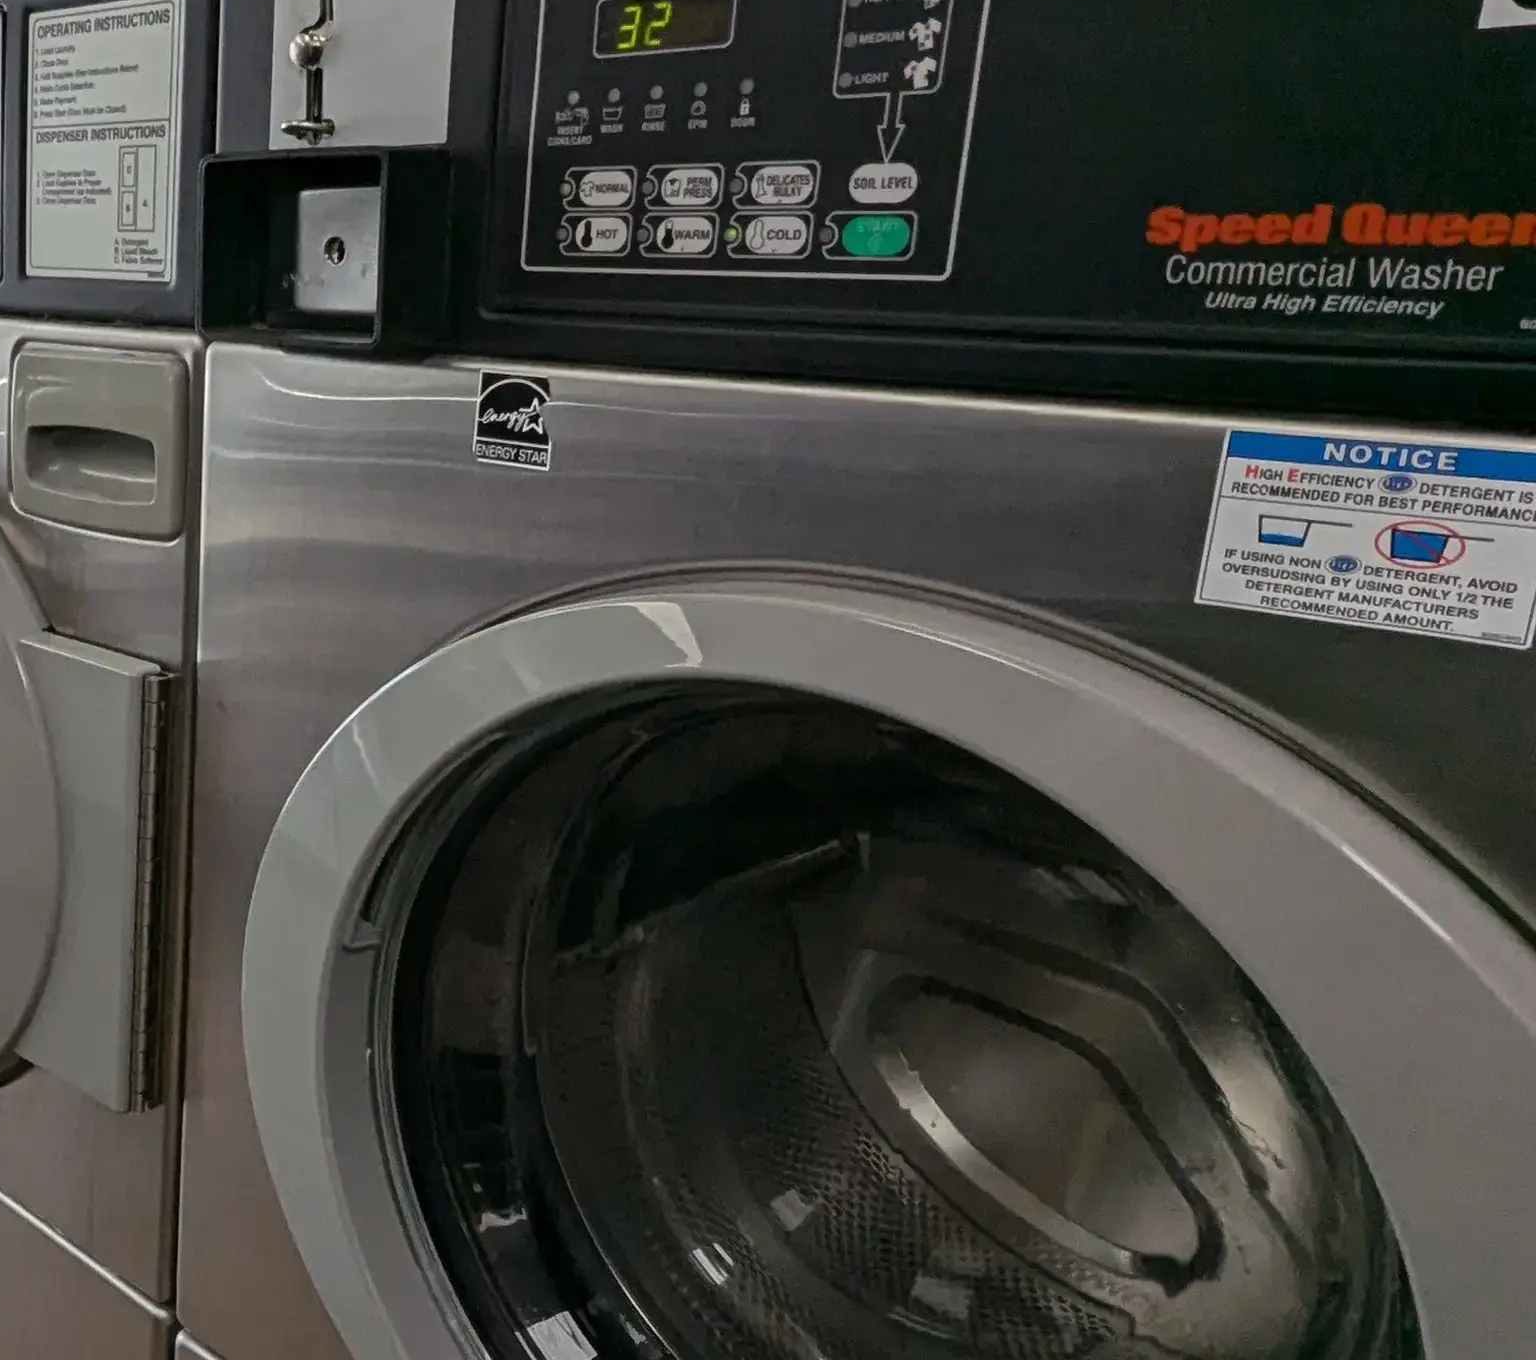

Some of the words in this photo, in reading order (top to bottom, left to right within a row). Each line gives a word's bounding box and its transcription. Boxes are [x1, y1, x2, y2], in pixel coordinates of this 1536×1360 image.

[37, 19, 92, 40] OPERATING
[94, 9, 171, 32] INSTRUCTIONS
[618, 0, 673, 49] 32
[859, 31, 905, 45] MEDIUM
[854, 72, 890, 85] LIGHT
[36, 129, 89, 144] DISPENSER
[91, 125, 166, 141] INSTRUCTIONS
[766, 174, 811, 186] DELICATES
[853, 176, 877, 190] SOIL
[880, 176, 913, 190] LEVEL
[595, 228, 619, 240] HOT
[672, 229, 711, 241] WARM
[766, 228, 802, 241] COLD
[1146, 202, 1334, 253] Speed
[1165, 254, 1356, 288] Commercial
[1369, 257, 1506, 293] Washer
[1204, 291, 1257, 311] Ultra
[1263, 293, 1317, 317] High
[1321, 295, 1445, 321] Efficiency
[475, 443, 517, 460] ENERGY
[518, 448, 547, 464] STAR
[1322, 442, 1460, 471] NOTICE
[1244, 464, 1283, 483] HIGH
[1287, 468, 1376, 490] EFFICIENCY
[1419, 482, 1516, 503] DETERGENT
[1519, 491, 1535, 505] IS
[1231, 481, 1341, 504] RECOMMENDED
[1344, 492, 1375, 508] FOR
[1378, 495, 1419, 511] BEST
[1421, 499, 1536, 522] PERFORMANC
[1221, 562, 1326, 586] OVERSUDSING
[1330, 576, 1351, 588] BY
[1355, 579, 1403, 596] USING
[1408, 585, 1452, 602] ONLY
[1455, 591, 1478, 605] 1/2
[1481, 595, 1514, 610] THE
[1224, 548, 1237, 559] IF
[1240, 551, 1285, 566] USING
[1289, 556, 1322, 570] NON
[1467, 577, 1518, 595] AVOID
[1244, 579, 1334, 601] DETERGENT
[1337, 591, 1480, 621] MANUFACTURERS
[1259, 595, 1379, 621] RECOMMENDED
[1382, 611, 1455, 633] AMOUNT.
